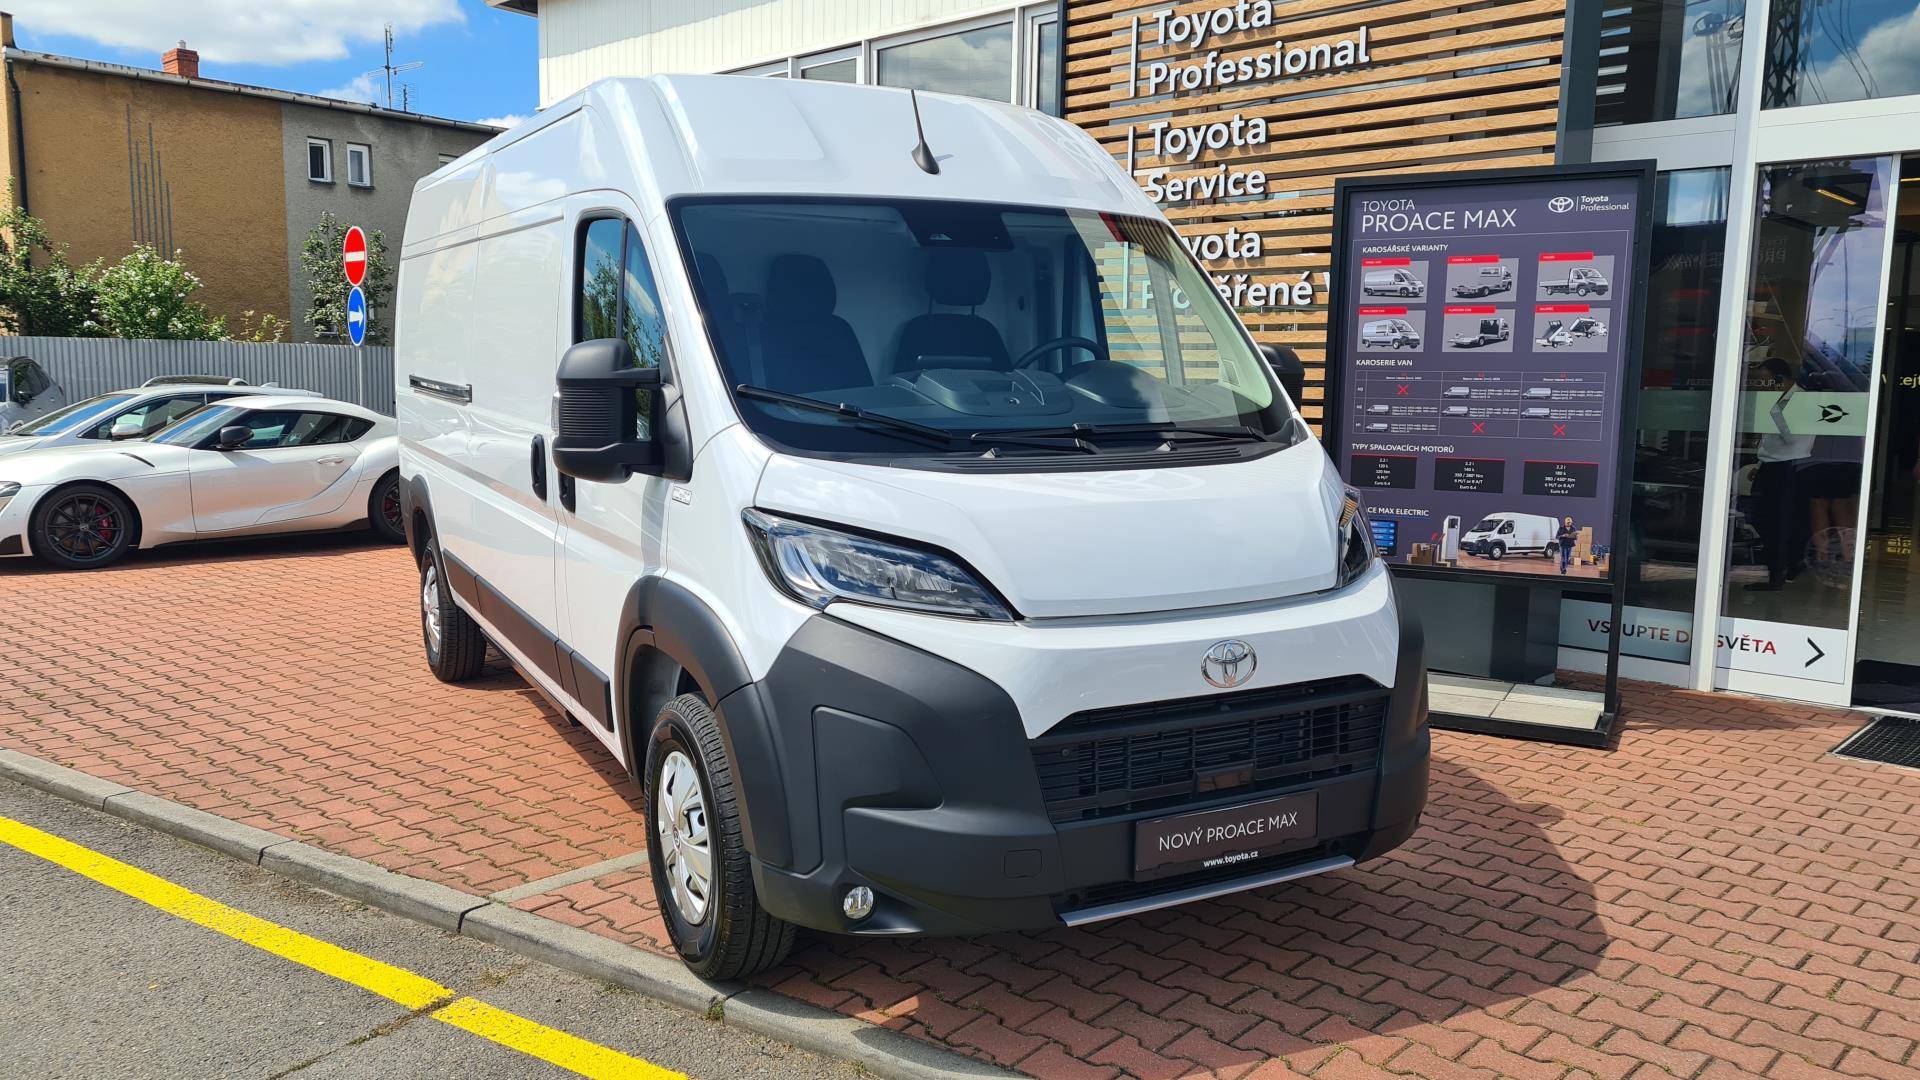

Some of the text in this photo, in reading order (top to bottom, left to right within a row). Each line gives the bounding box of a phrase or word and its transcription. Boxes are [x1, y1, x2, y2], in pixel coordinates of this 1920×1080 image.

[1153, 0, 1273, 48] Toyota
[1150, 26, 1370, 94] Professional
[1148, 114, 1267, 160] Toyota
[1146, 164, 1266, 202] Service
[1362, 199, 1415, 212] TOYOTA
[1581, 195, 1609, 204] Toyota
[1581, 202, 1630, 212] Professional
[1362, 208, 1517, 232] PROACE MAX
[1182, 227, 1260, 260] yota
[1362, 244, 1448, 254] KAROSÁŘSKÉ VARIANTY
[1588, 619, 1690, 643] VSUPTE D
[1717, 634, 1776, 655] SVĚTA
[1160, 812, 1298, 851] NOVÝ PROACE MAX
[1204, 851, 1258, 867] www.toyota.cz
